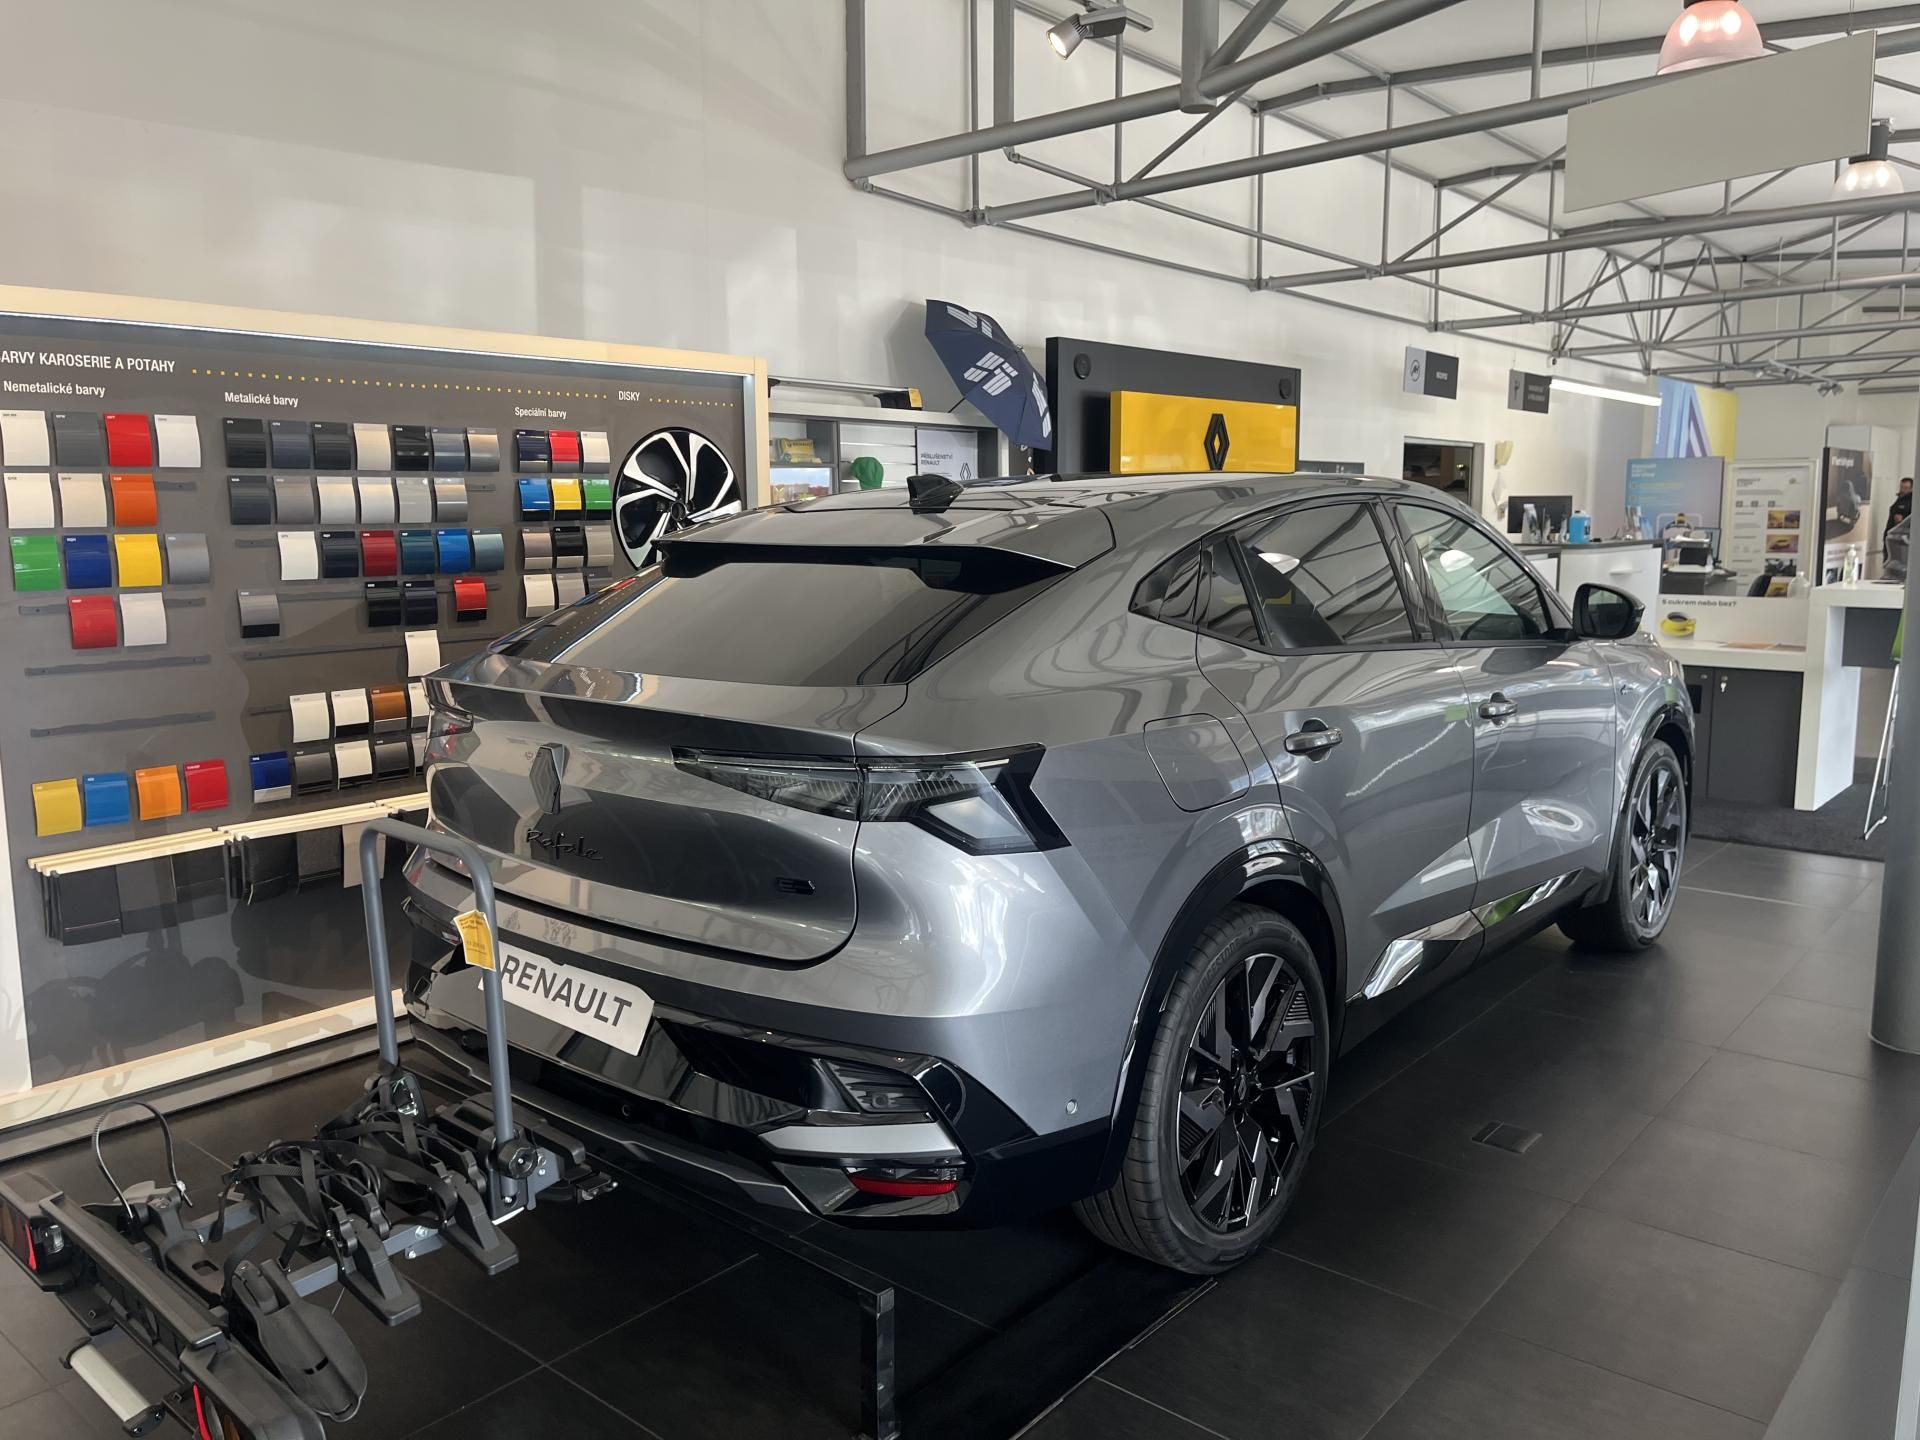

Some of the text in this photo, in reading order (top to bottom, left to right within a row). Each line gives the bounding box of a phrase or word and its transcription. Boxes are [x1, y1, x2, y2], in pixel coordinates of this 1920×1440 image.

[0, 350, 175, 373] ARVY KAROSERIE A POTAHY
[3, 380, 106, 398] Nemetalické barvy
[618, 390, 640, 401] DISKY
[224, 391, 299, 408] Metalické barvy
[514, 406, 567, 420] Speciální barvy
[525, 827, 605, 861] Rafale
[501, 954, 633, 1028] RENAULT
